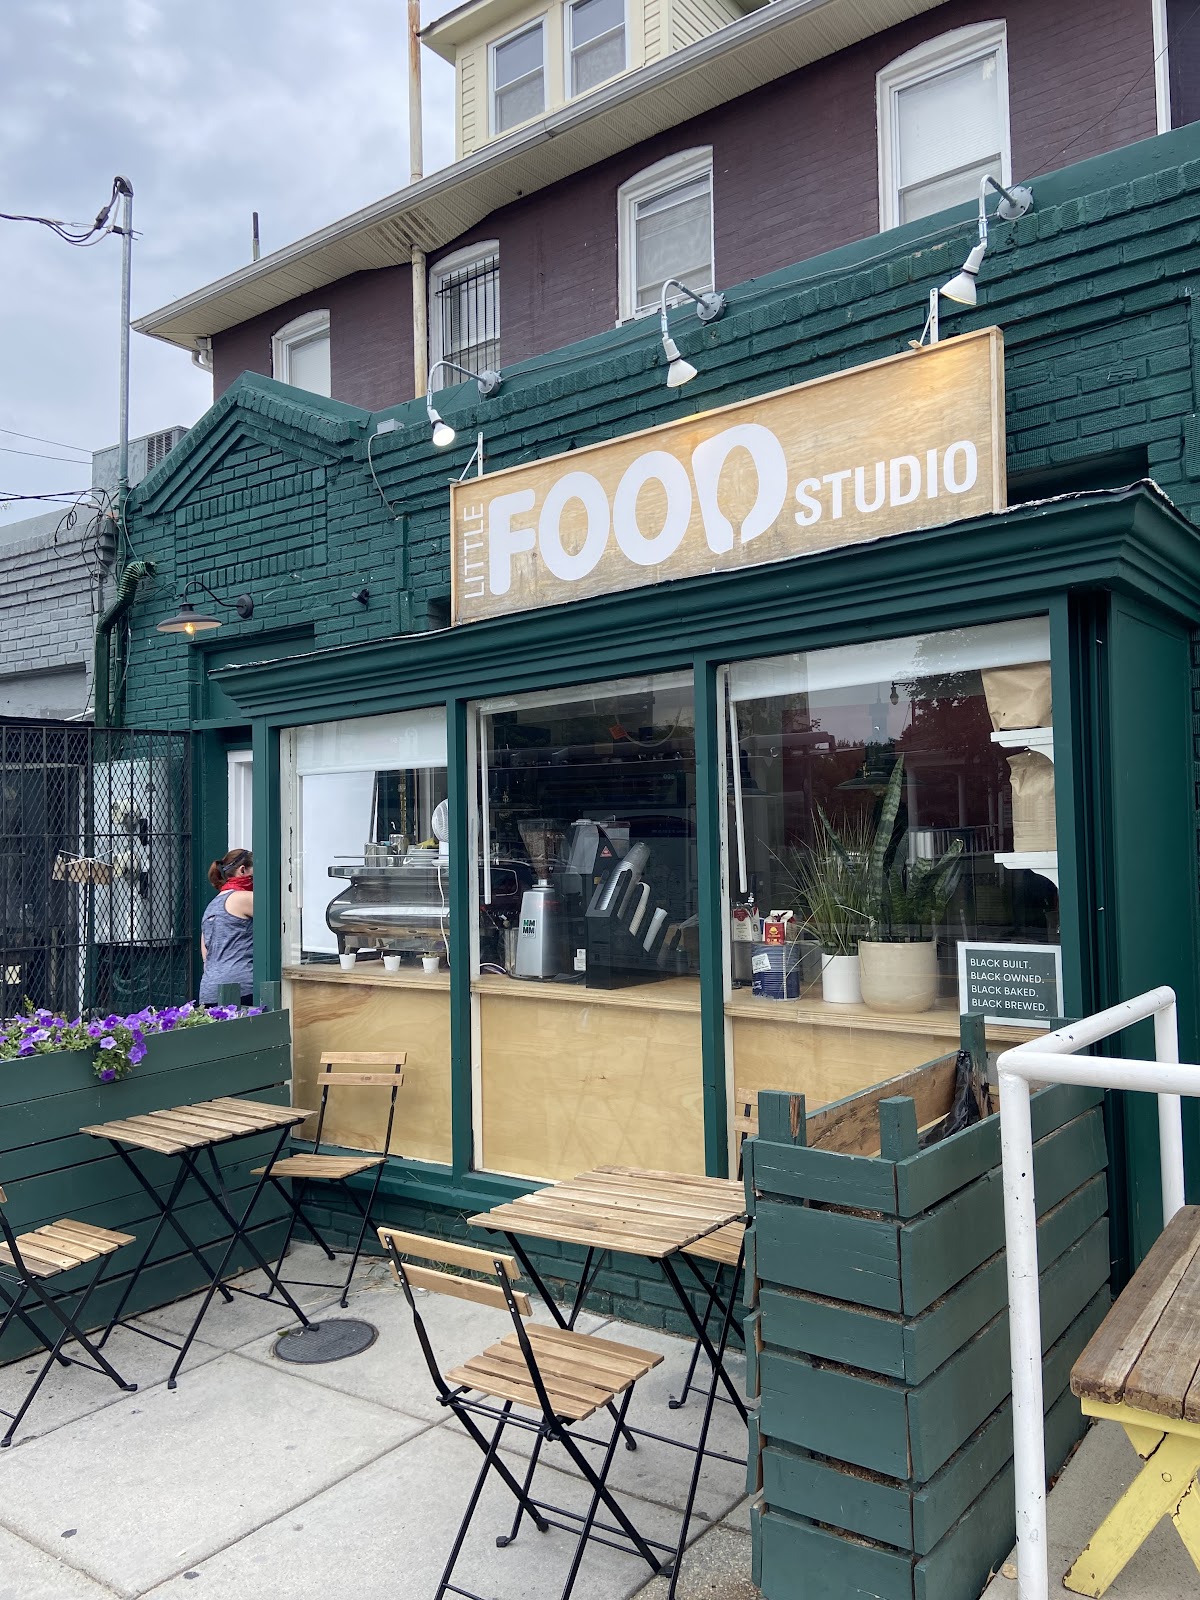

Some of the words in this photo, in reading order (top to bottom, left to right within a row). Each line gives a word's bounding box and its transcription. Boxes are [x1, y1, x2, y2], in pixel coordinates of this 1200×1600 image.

[489, 423, 788, 596] FOOD
[794, 440, 978, 526] STUDIO
[464, 503, 485, 599] LITTLE
[970, 958, 1000, 968] BLACK
[1003, 960, 1031, 969] BUILT.
[970, 971, 1001, 981] BLACK
[1003, 973, 1045, 984] OWNED.
[971, 985, 1001, 995] BLACK
[1004, 987, 1039, 998] BAKED.
[971, 998, 1002, 1008] BLACK
[1004, 1000, 1049, 1012] BREWED.
